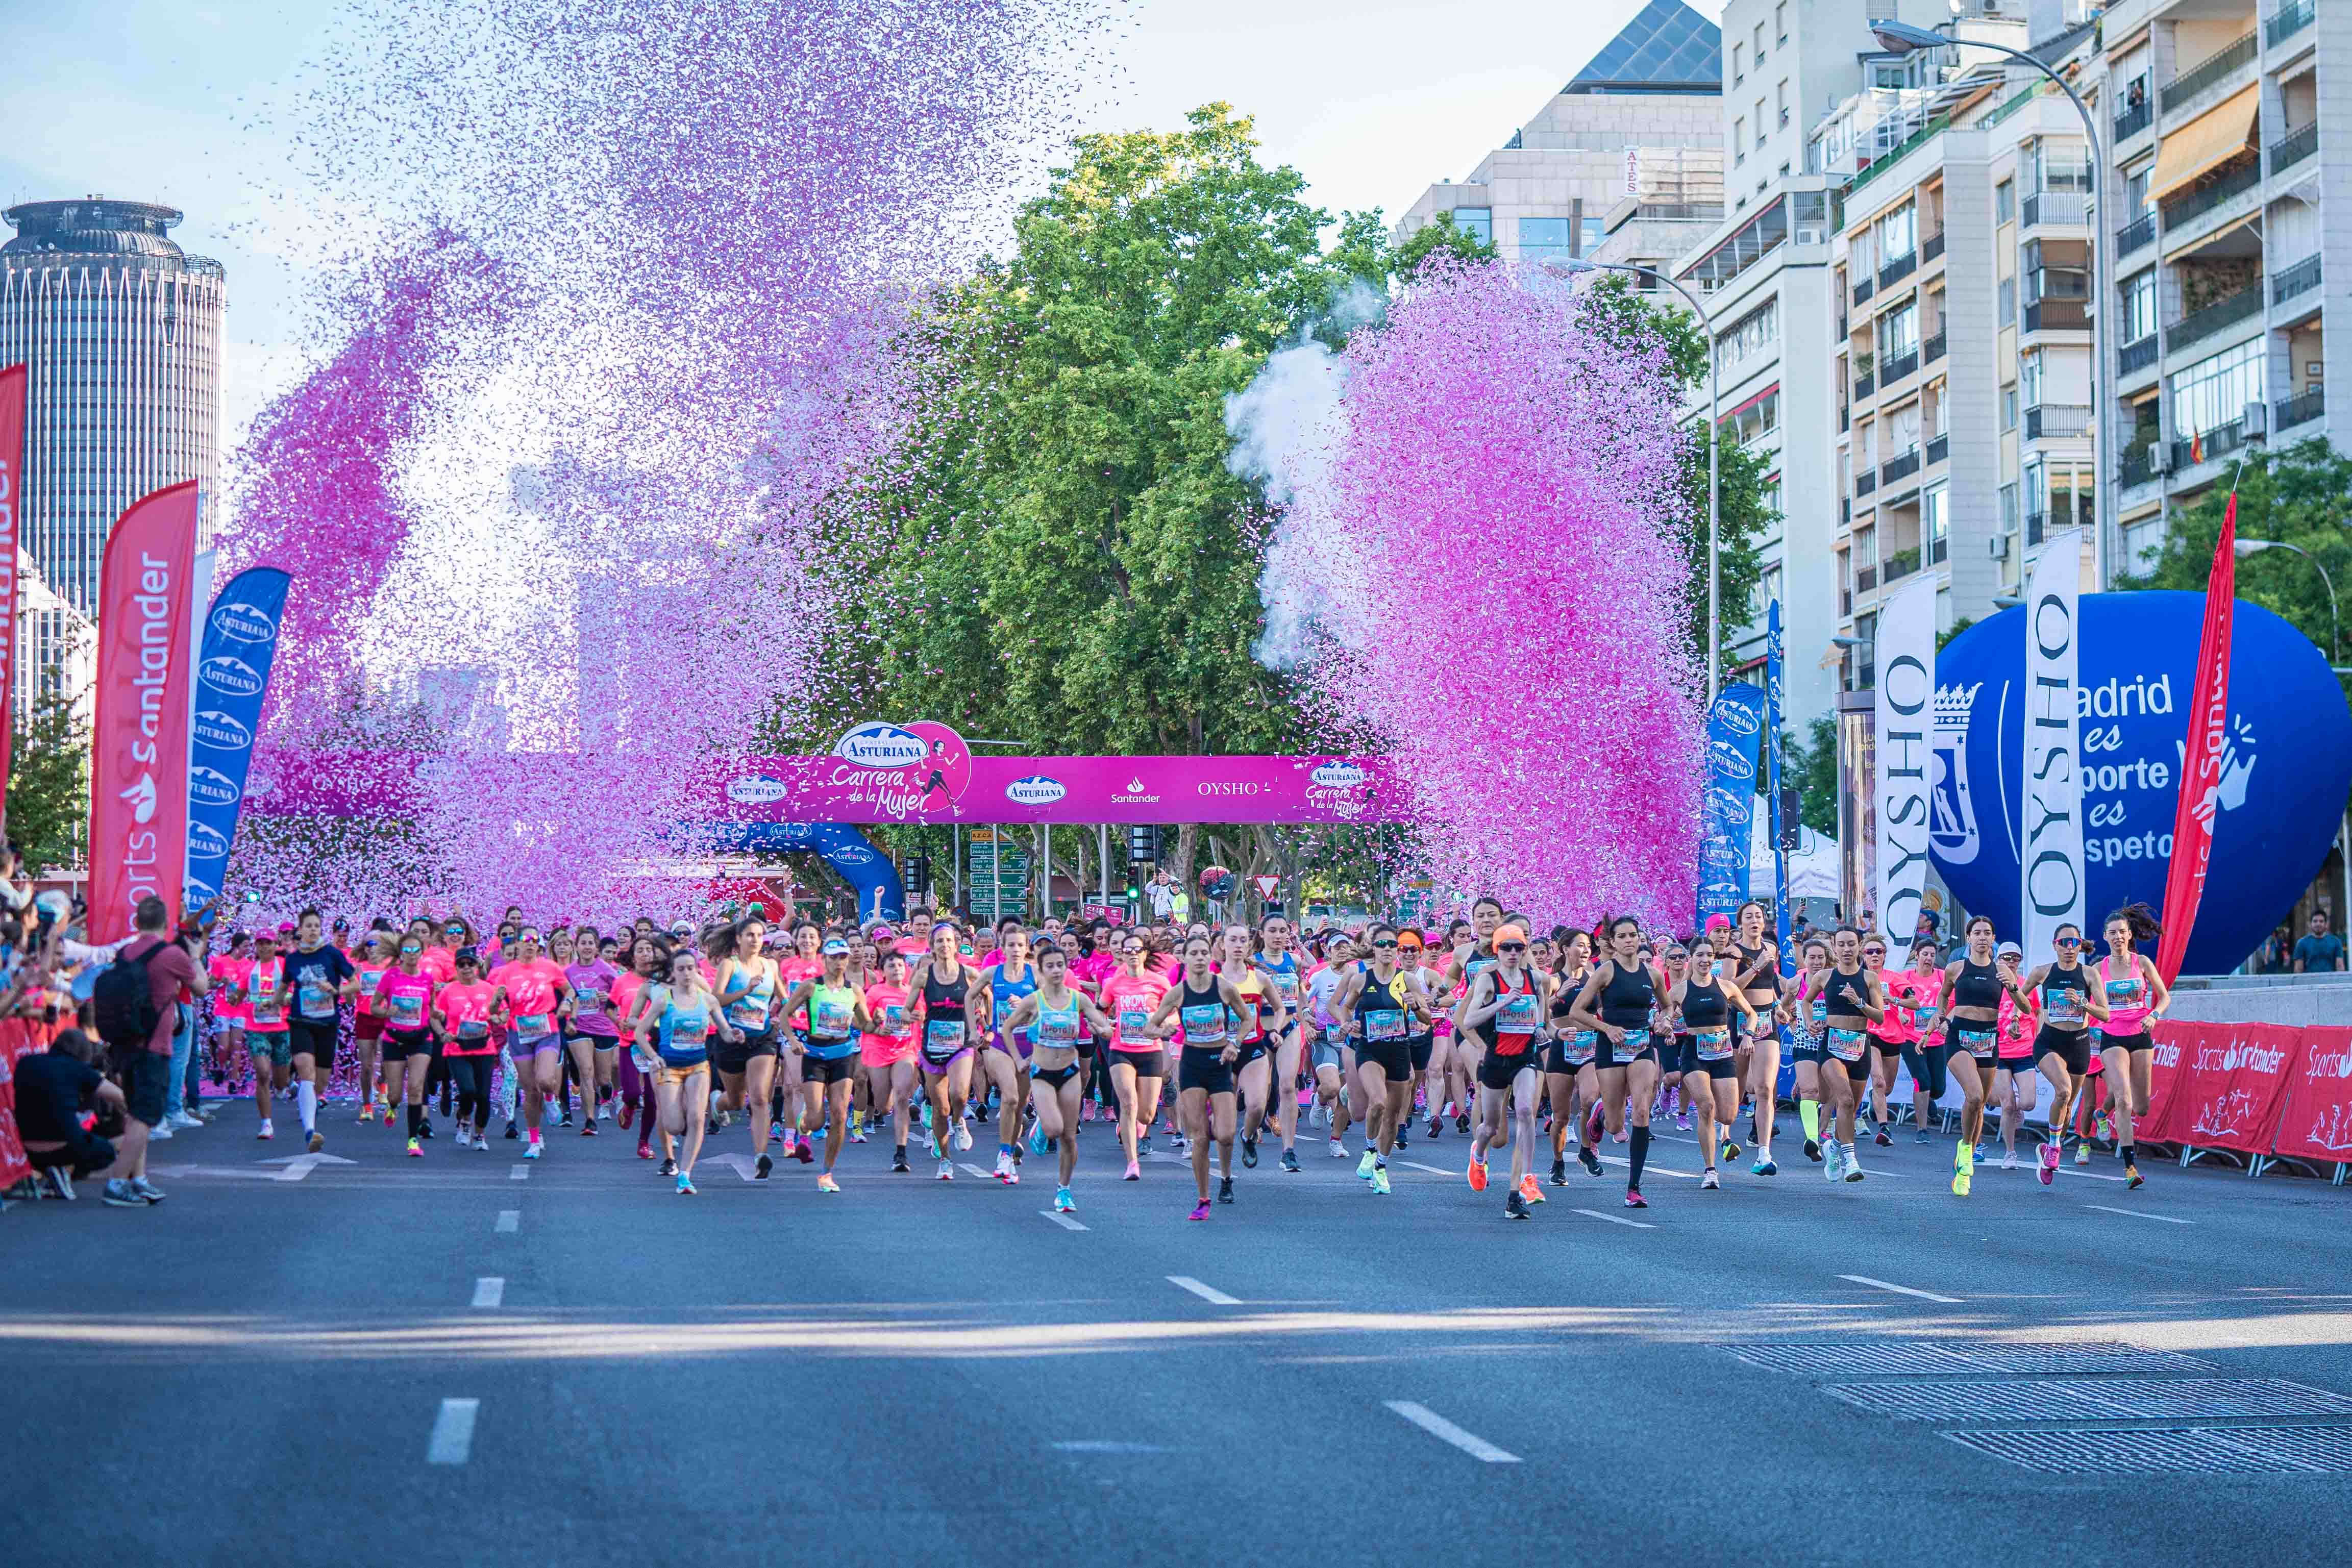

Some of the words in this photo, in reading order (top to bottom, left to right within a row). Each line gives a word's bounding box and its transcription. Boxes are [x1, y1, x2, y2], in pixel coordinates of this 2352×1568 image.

[218, 612, 268, 638] ASTURIANA
[132, 552, 168, 764] Santander
[203, 664, 256, 690] ASTURIANA
[2077, 674, 2173, 718] adrid
[197, 724, 243, 745] STURIANA
[2084, 725, 2123, 753] es
[849, 741, 921, 757] ASTURIANA
[2028, 594, 2077, 916] OYSHO
[832, 765, 905, 786] Carrera
[1198, 782, 1258, 795] OYSHO
[2081, 758, 2169, 799] porte
[191, 783, 233, 800] TURIANA
[850, 787, 863, 802] de
[866, 787, 876, 802] la
[873, 786, 931, 820] Mujer
[1010, 786, 1061, 797] ASTURIANA
[1110, 794, 1160, 803] Santander
[1305, 784, 1351, 799] Carrera
[1317, 800, 1326, 809] de
[1327, 800, 1333, 809] la
[1886, 655, 1927, 946] OYSHO
[2089, 800, 2126, 828] es
[2192, 1039, 2224, 1077] Sports
[2306, 1044, 2342, 1085] Sports
